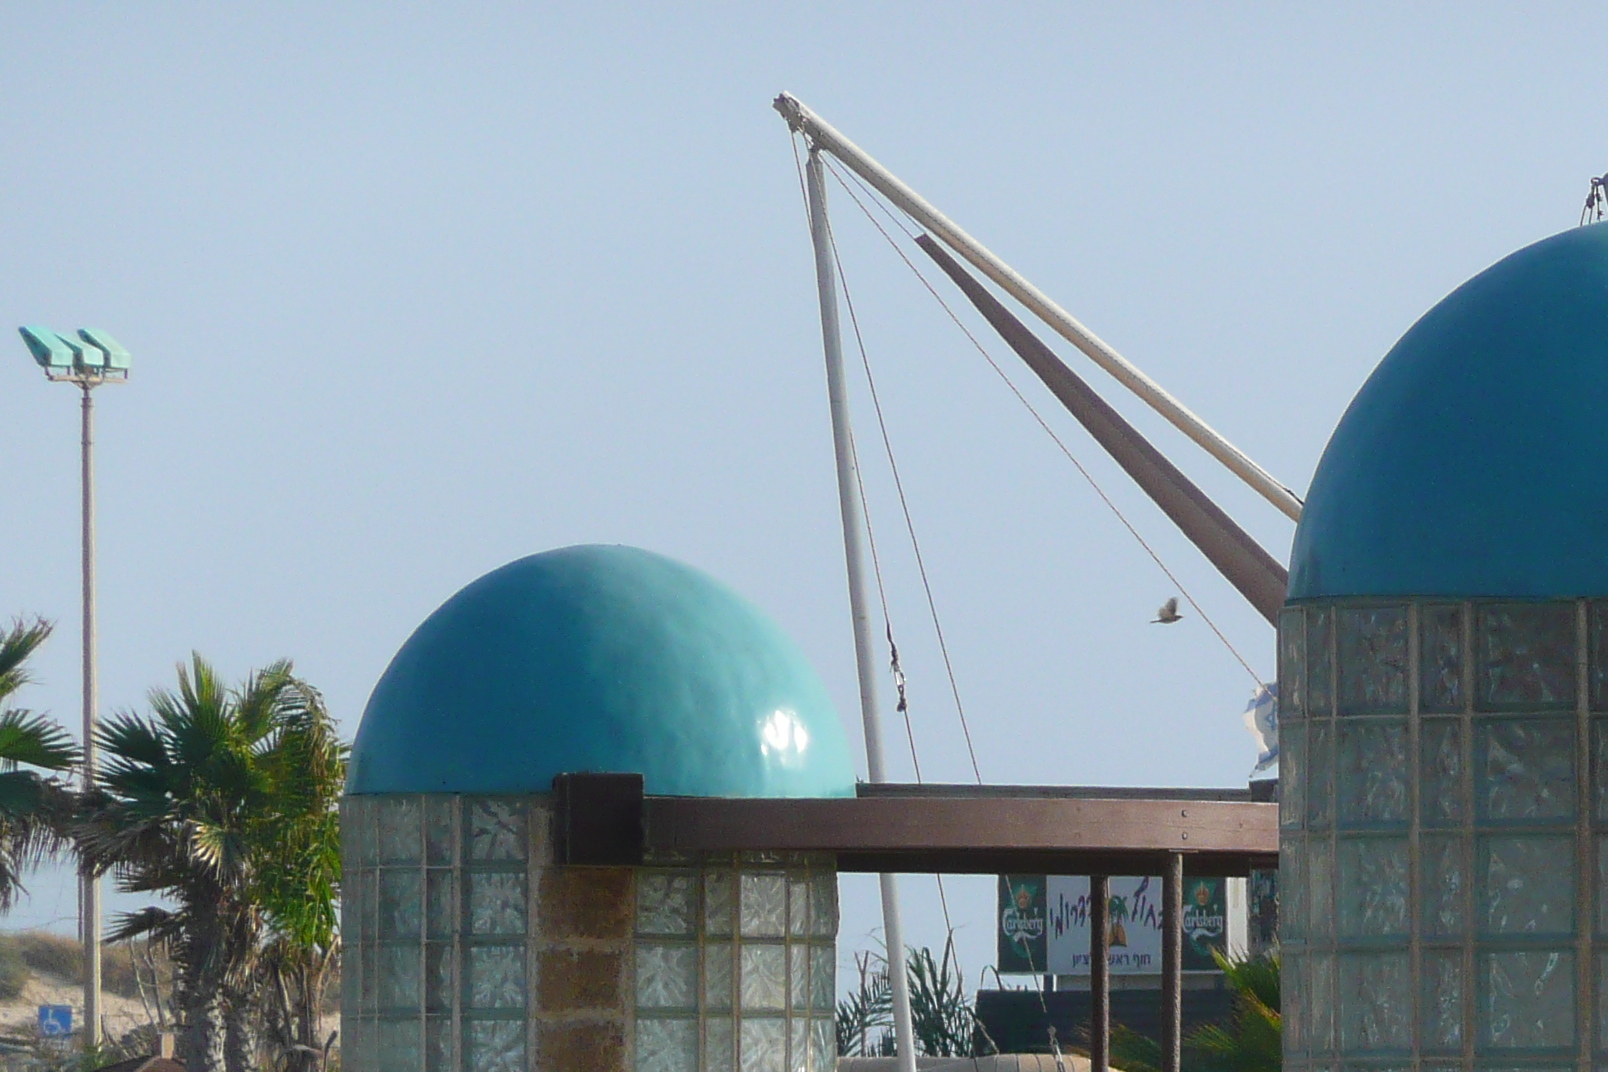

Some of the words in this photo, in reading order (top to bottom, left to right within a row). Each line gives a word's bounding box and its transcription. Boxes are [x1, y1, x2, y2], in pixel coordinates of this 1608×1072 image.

[1003, 907, 1043, 937] Carlsberg
[1182, 904, 1223, 935] Carlsberg
[1072, 953, 1090, 968] ציון
[1108, 954, 1130, 965] ראש
[1133, 953, 1151, 967] חוף
